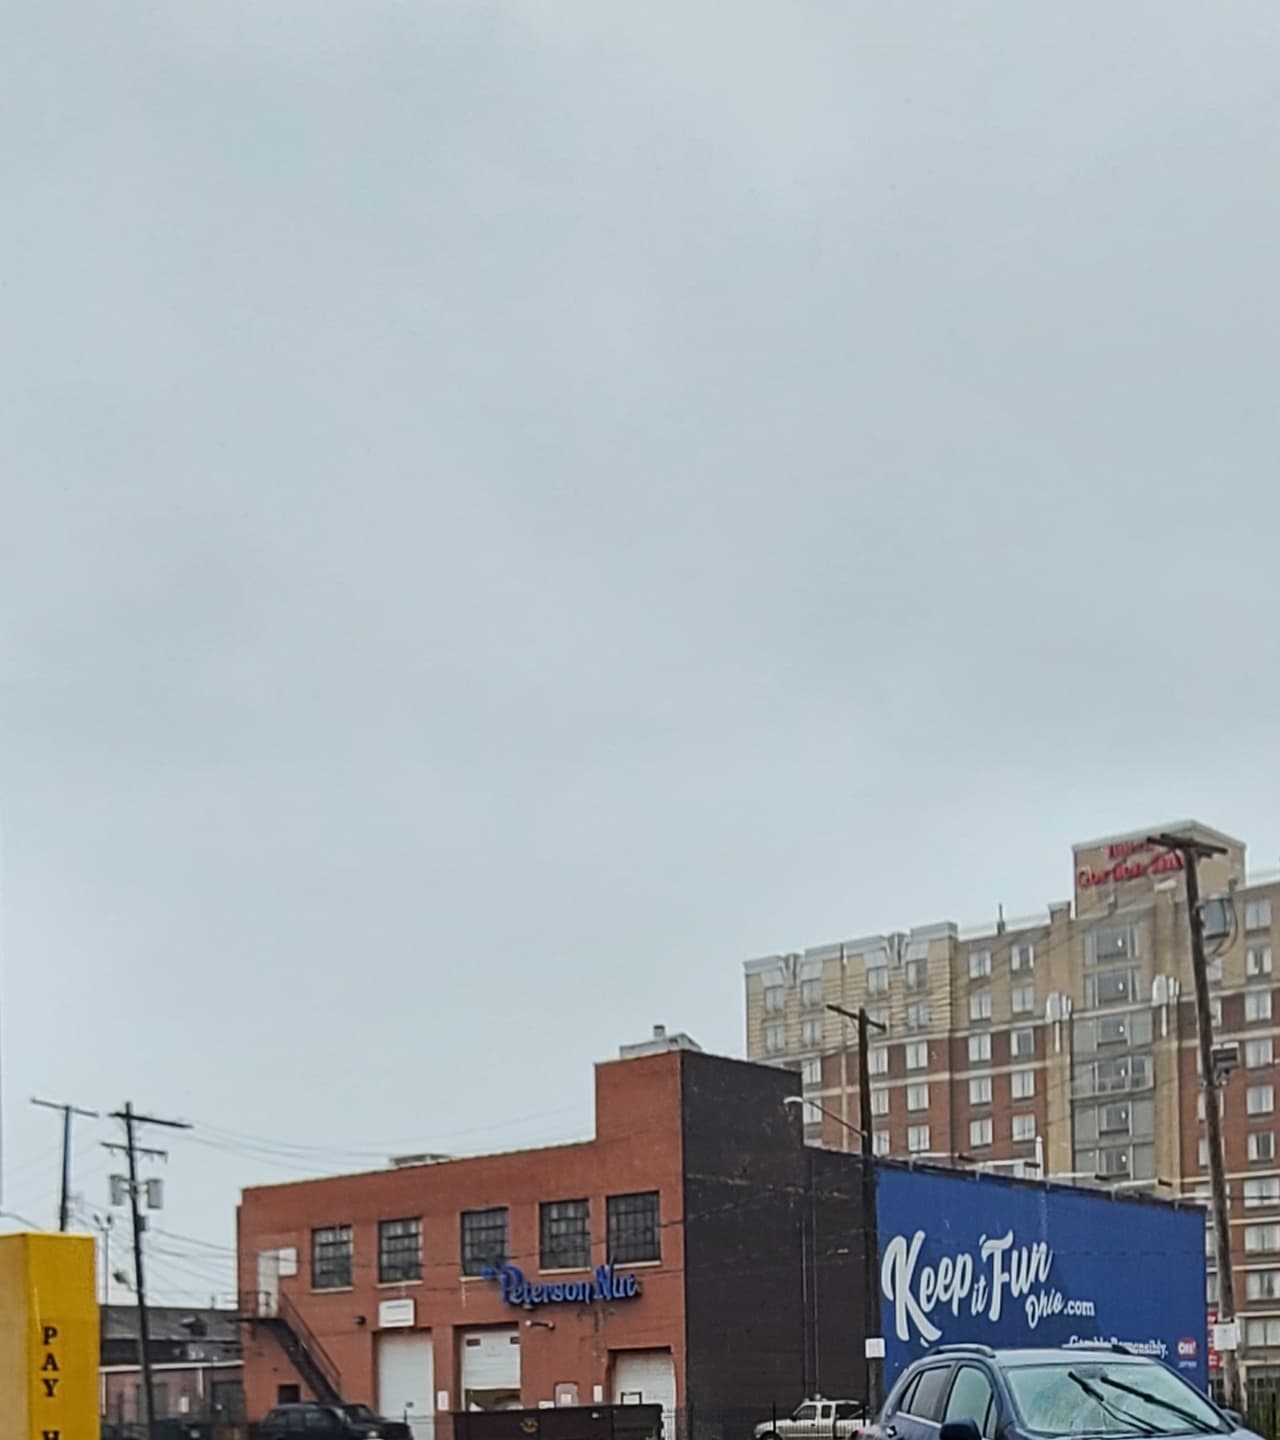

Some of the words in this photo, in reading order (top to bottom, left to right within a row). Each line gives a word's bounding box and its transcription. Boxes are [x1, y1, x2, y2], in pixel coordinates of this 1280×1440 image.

[496, 1263, 591, 1306] Peterson
[881, 1230, 974, 1348] Keep
[970, 1276, 990, 1317] it
[979, 1230, 1053, 1322] Fun
[41, 1326, 60, 1398] PAY
